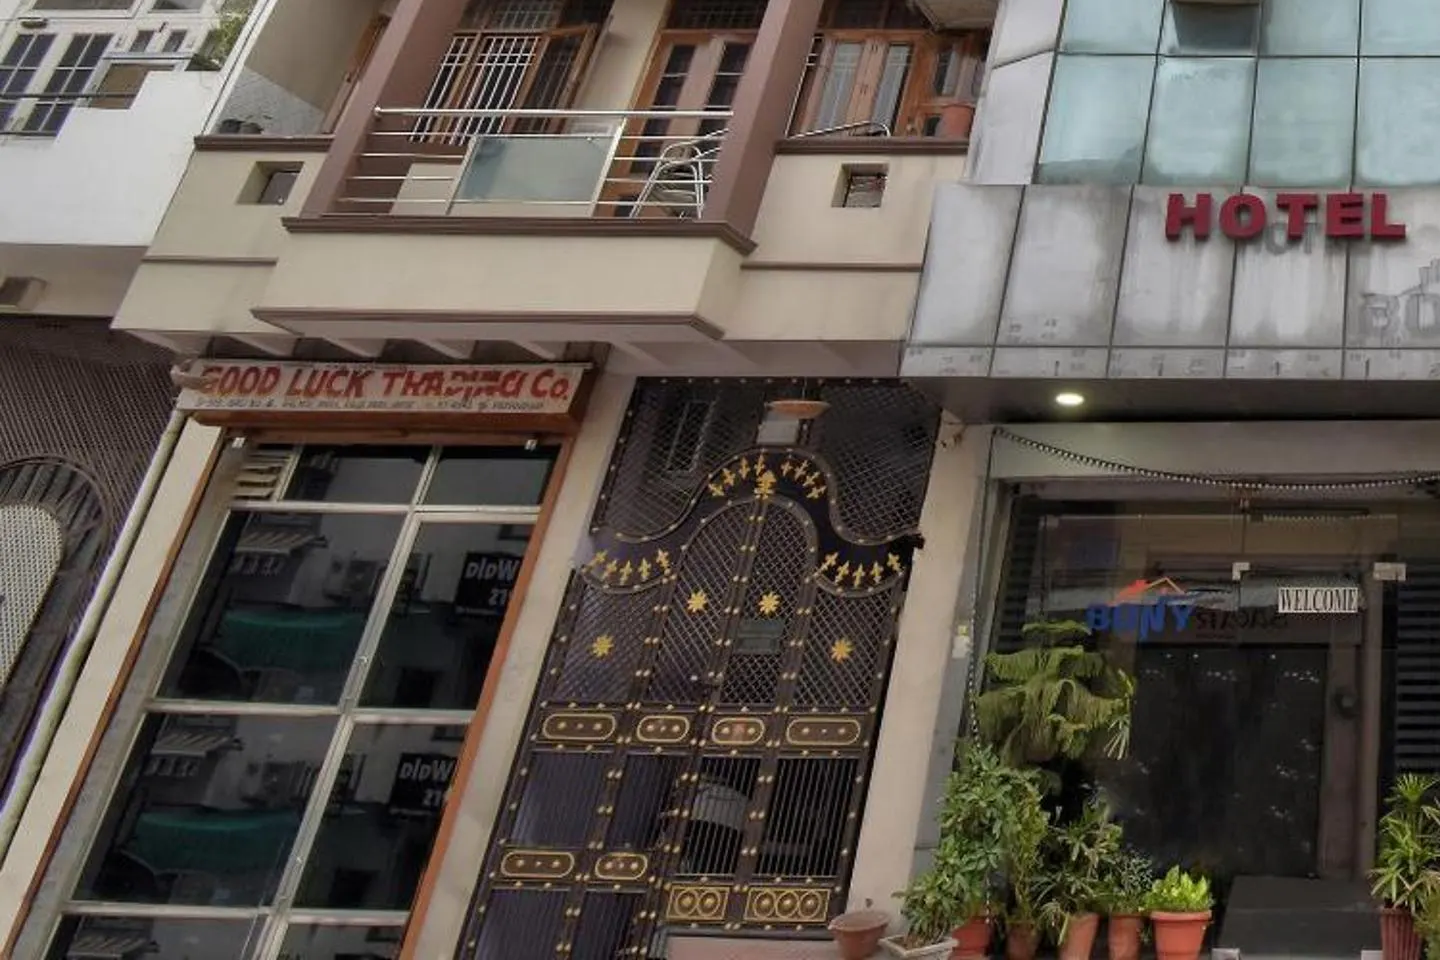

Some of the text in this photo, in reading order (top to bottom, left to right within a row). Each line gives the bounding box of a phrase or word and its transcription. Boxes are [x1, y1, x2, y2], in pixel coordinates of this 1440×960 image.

[1165, 193, 1406, 240] HOTEL
[200, 364, 282, 396] GOOD
[285, 367, 374, 398] LUCK
[1280, 588, 1357, 611] WELCOME
